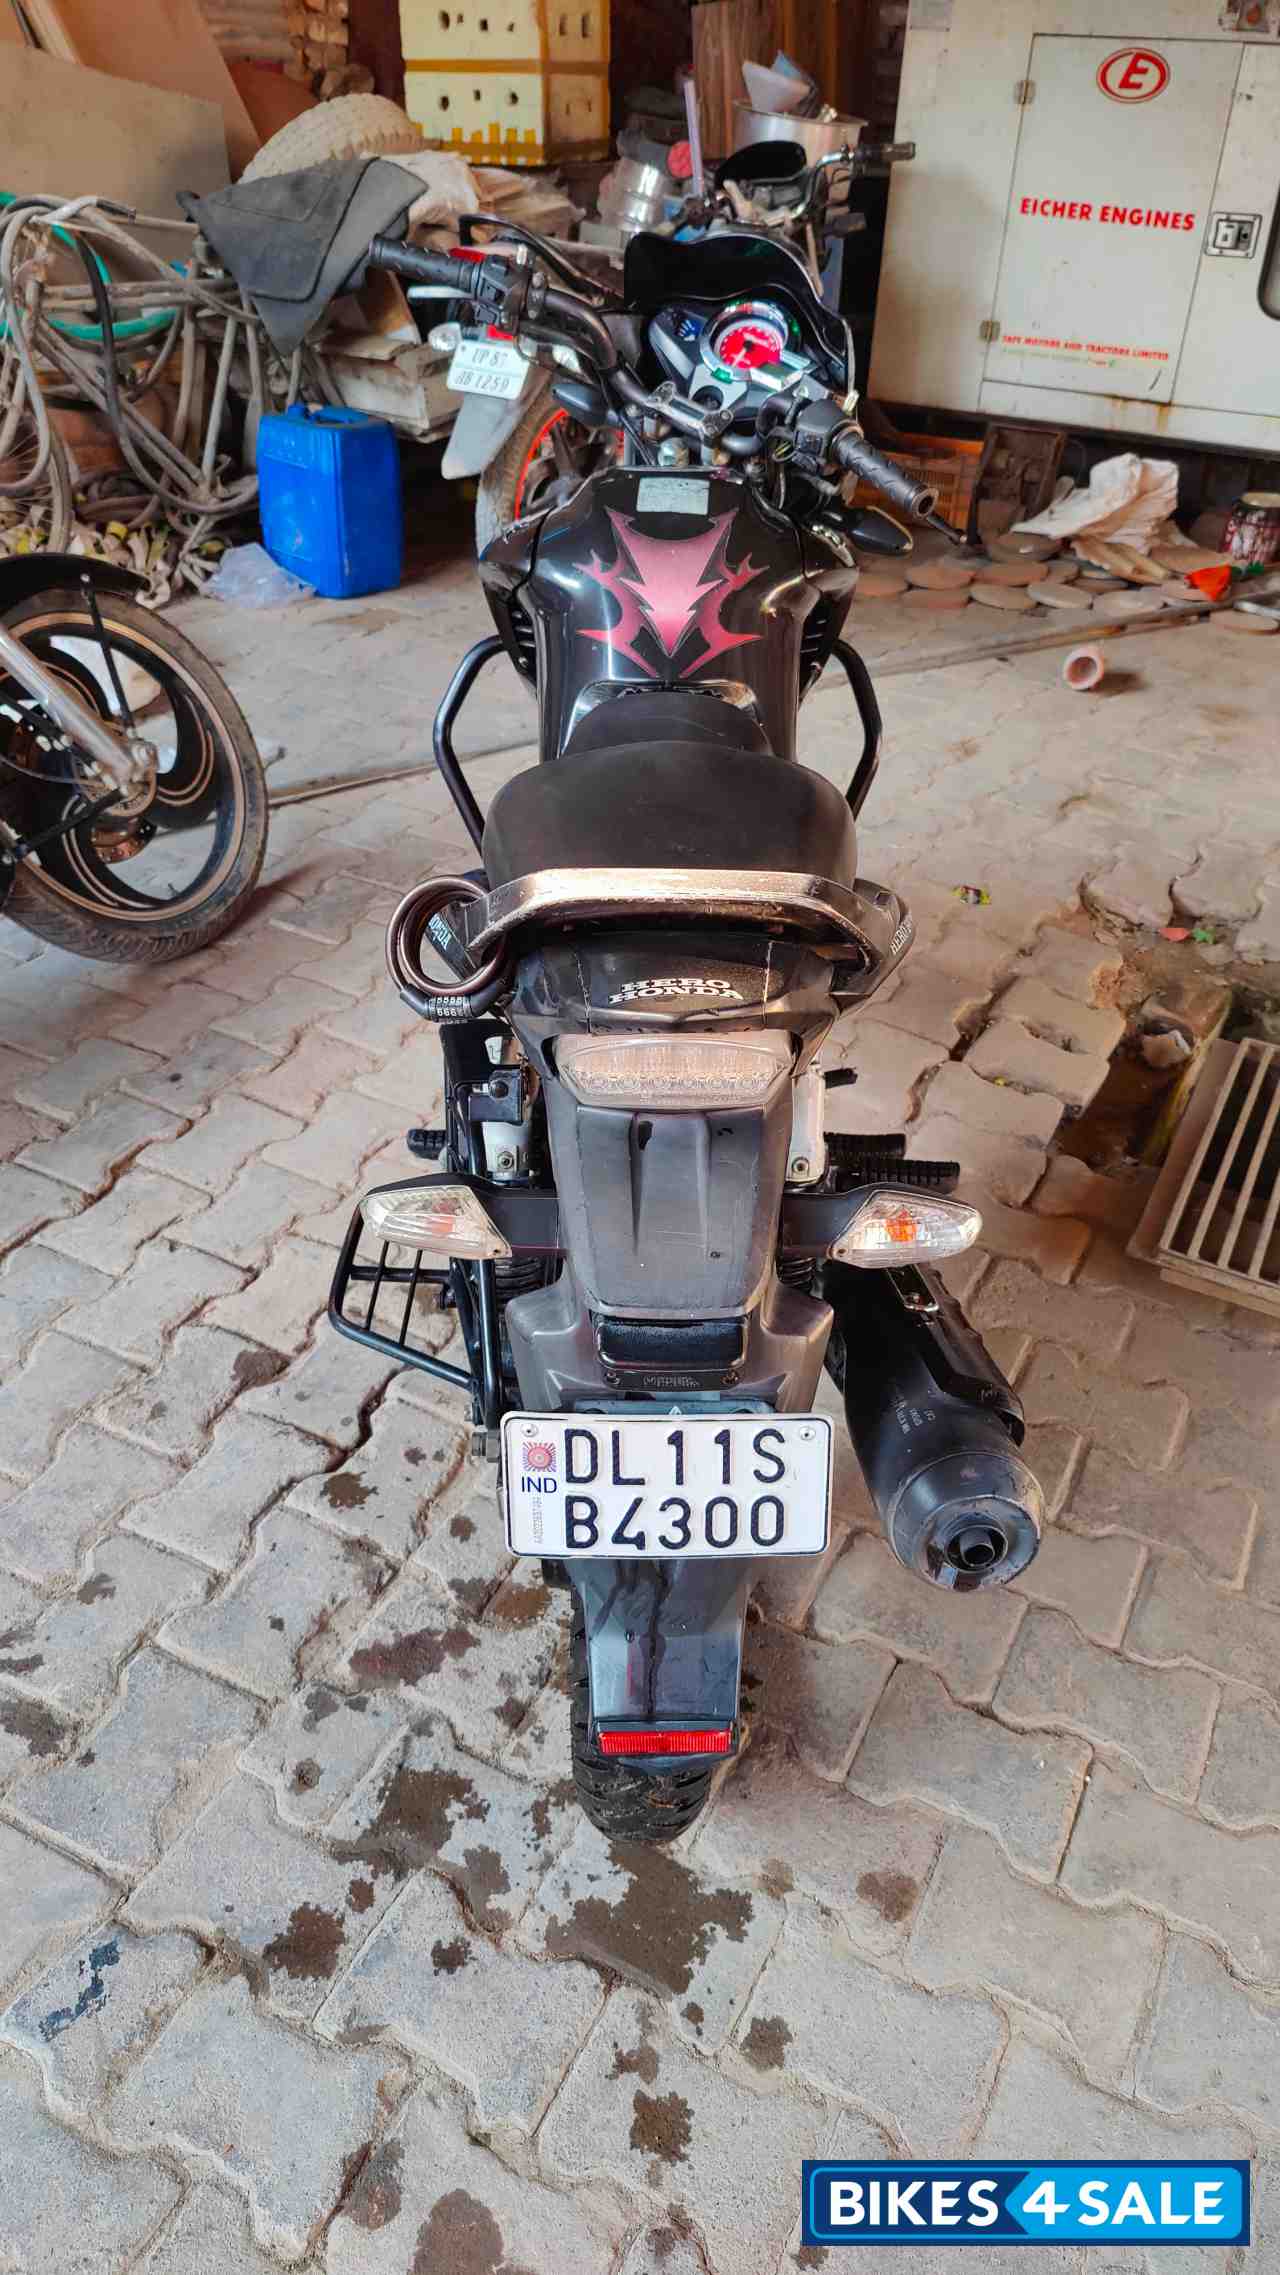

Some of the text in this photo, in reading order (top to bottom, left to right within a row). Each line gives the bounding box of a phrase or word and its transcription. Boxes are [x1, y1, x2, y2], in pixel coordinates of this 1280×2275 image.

[1020, 197, 1196, 231] EICHER ENGINES
[621, 978, 731, 992] HERO
[608, 986, 744, 1004] HONDA
[521, 1476, 557, 1493] IND
[564, 1495, 785, 1550] B4300
